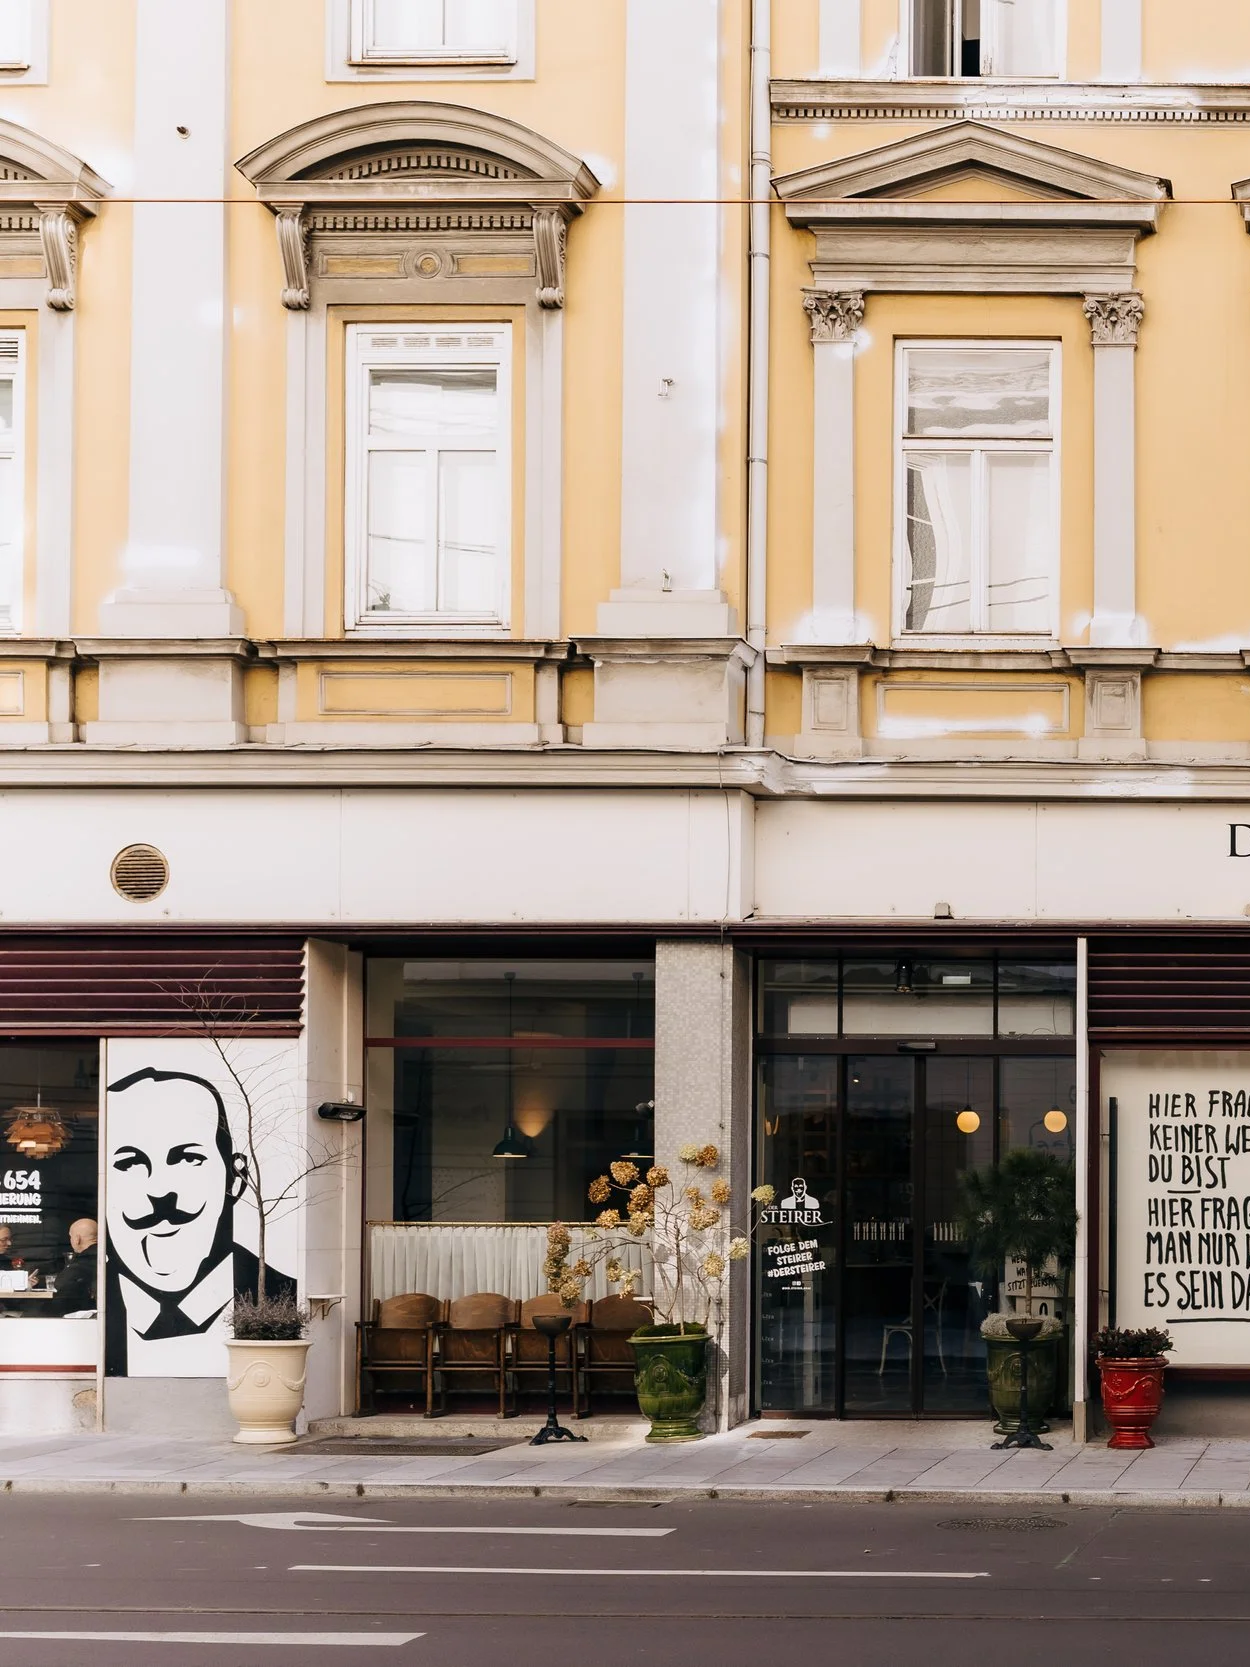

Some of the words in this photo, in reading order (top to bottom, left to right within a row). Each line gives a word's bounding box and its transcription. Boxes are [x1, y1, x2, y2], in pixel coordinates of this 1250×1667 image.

[1149, 1093, 1197, 1118] HIER
[1150, 1123, 1218, 1153] KEINER
[3, 1170, 42, 1190] 654
[1148, 1154, 1172, 1182] DU
[1181, 1155, 1230, 1189] BIST
[760, 1210, 833, 1227] STEIRER
[1148, 1198, 1195, 1228] HIER
[767, 1243, 796, 1256] FOLGE
[798, 1239, 818, 1250] DEM
[776, 1251, 813, 1266] STEIRER
[1146, 1231, 1192, 1265] MAN
[1198, 1232, 1239, 1267] NUR
[767, 1261, 826, 1278] #DERSTEIRER
[1144, 1272, 1170, 1308] ES
[1176, 1270, 1224, 1310] SEIN
